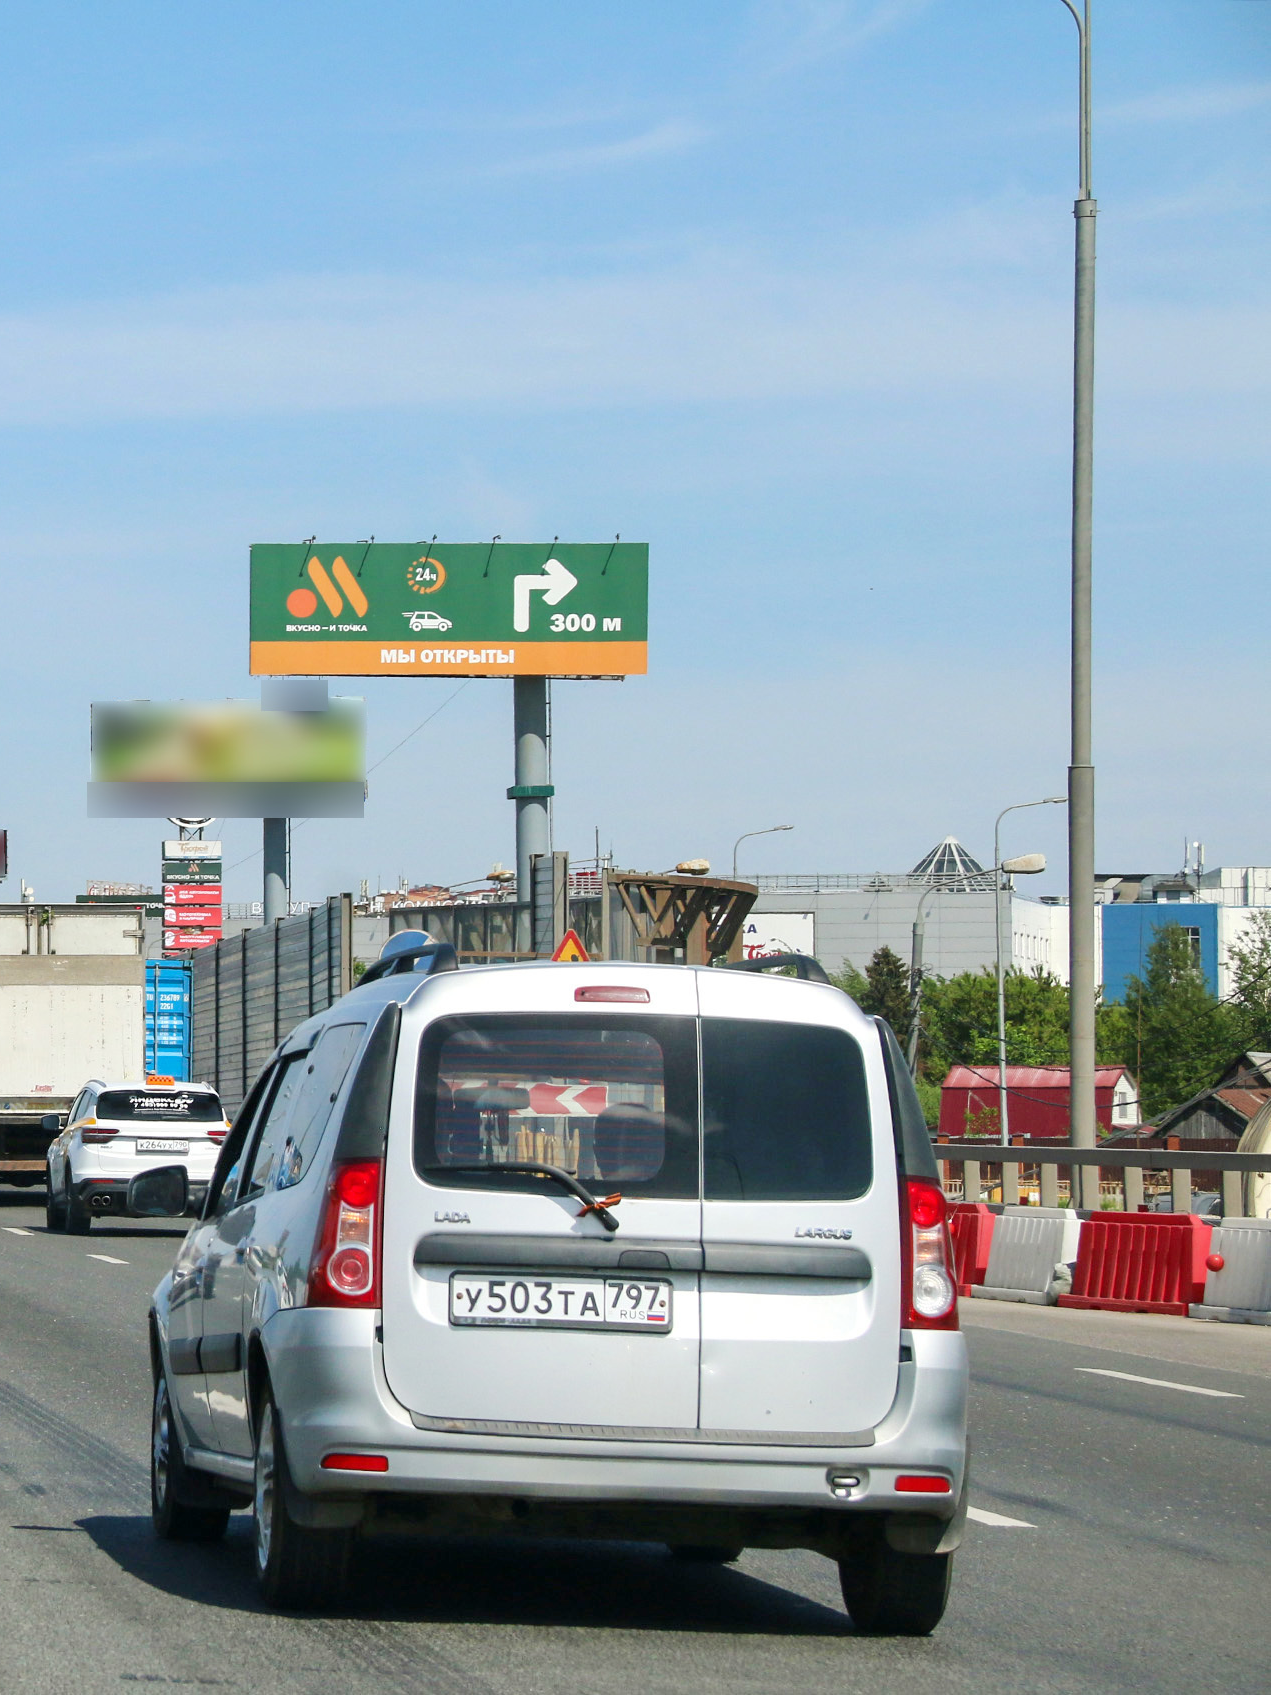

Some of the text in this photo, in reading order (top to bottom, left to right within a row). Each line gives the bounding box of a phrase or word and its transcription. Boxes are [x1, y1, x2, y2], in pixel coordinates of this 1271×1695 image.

[285, 624, 321, 632] ВКУСНО
[329, 624, 336, 632] И
[337, 624, 368, 632] ТОЧКА
[549, 613, 596, 632] 300
[380, 648, 515, 664] МЫ ОТКРЫТЫ
[434, 1210, 471, 1224] LADA
[794, 1226, 853, 1241] LARGUS
[465, 1280, 660, 1317] У503ТА 797
[620, 1310, 646, 1320] RUS
